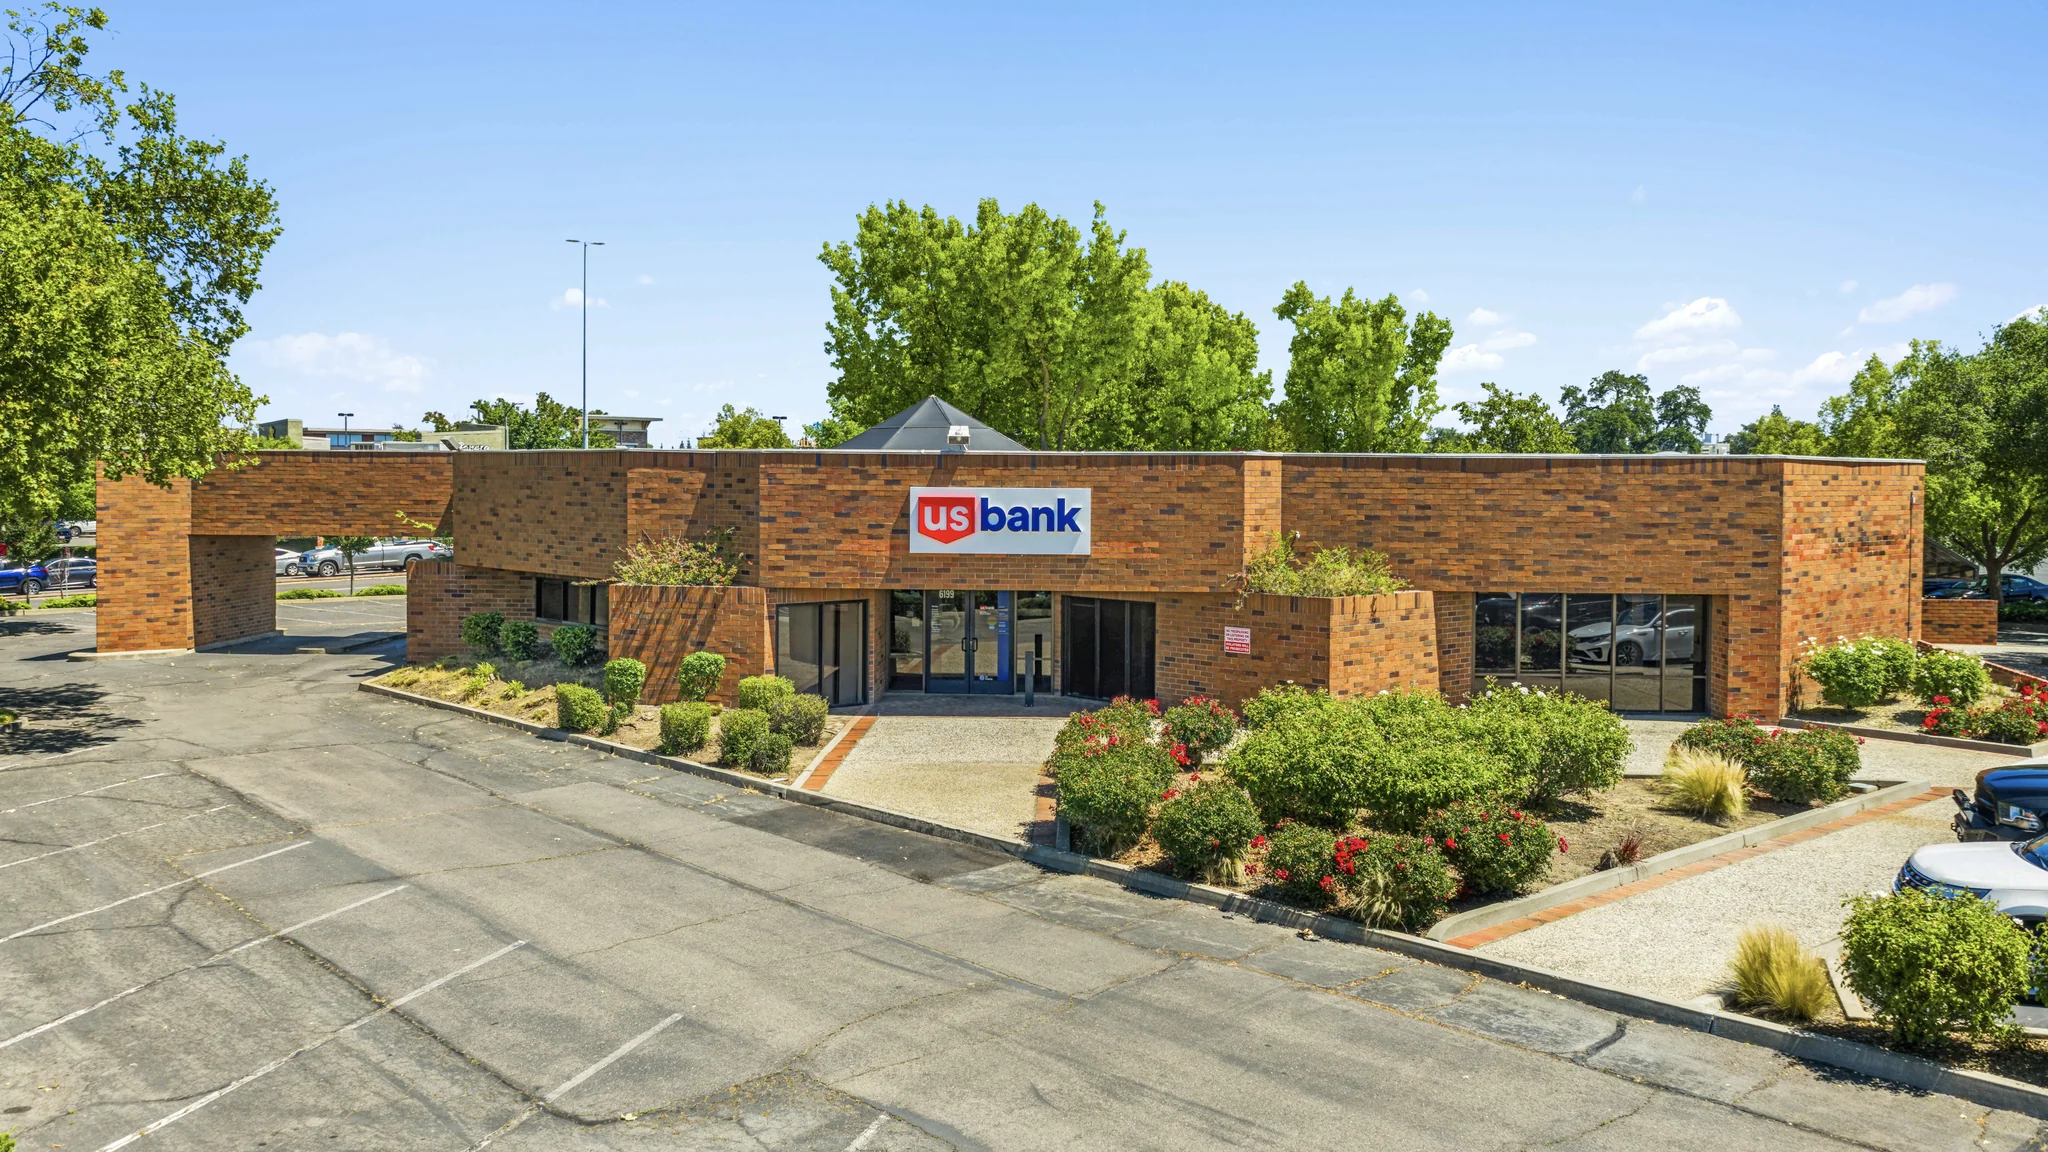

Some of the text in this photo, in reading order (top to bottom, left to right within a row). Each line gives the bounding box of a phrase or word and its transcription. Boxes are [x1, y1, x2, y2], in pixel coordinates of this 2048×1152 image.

[924, 497, 1082, 533] us bank
[938, 589, 955, 599] 6199
